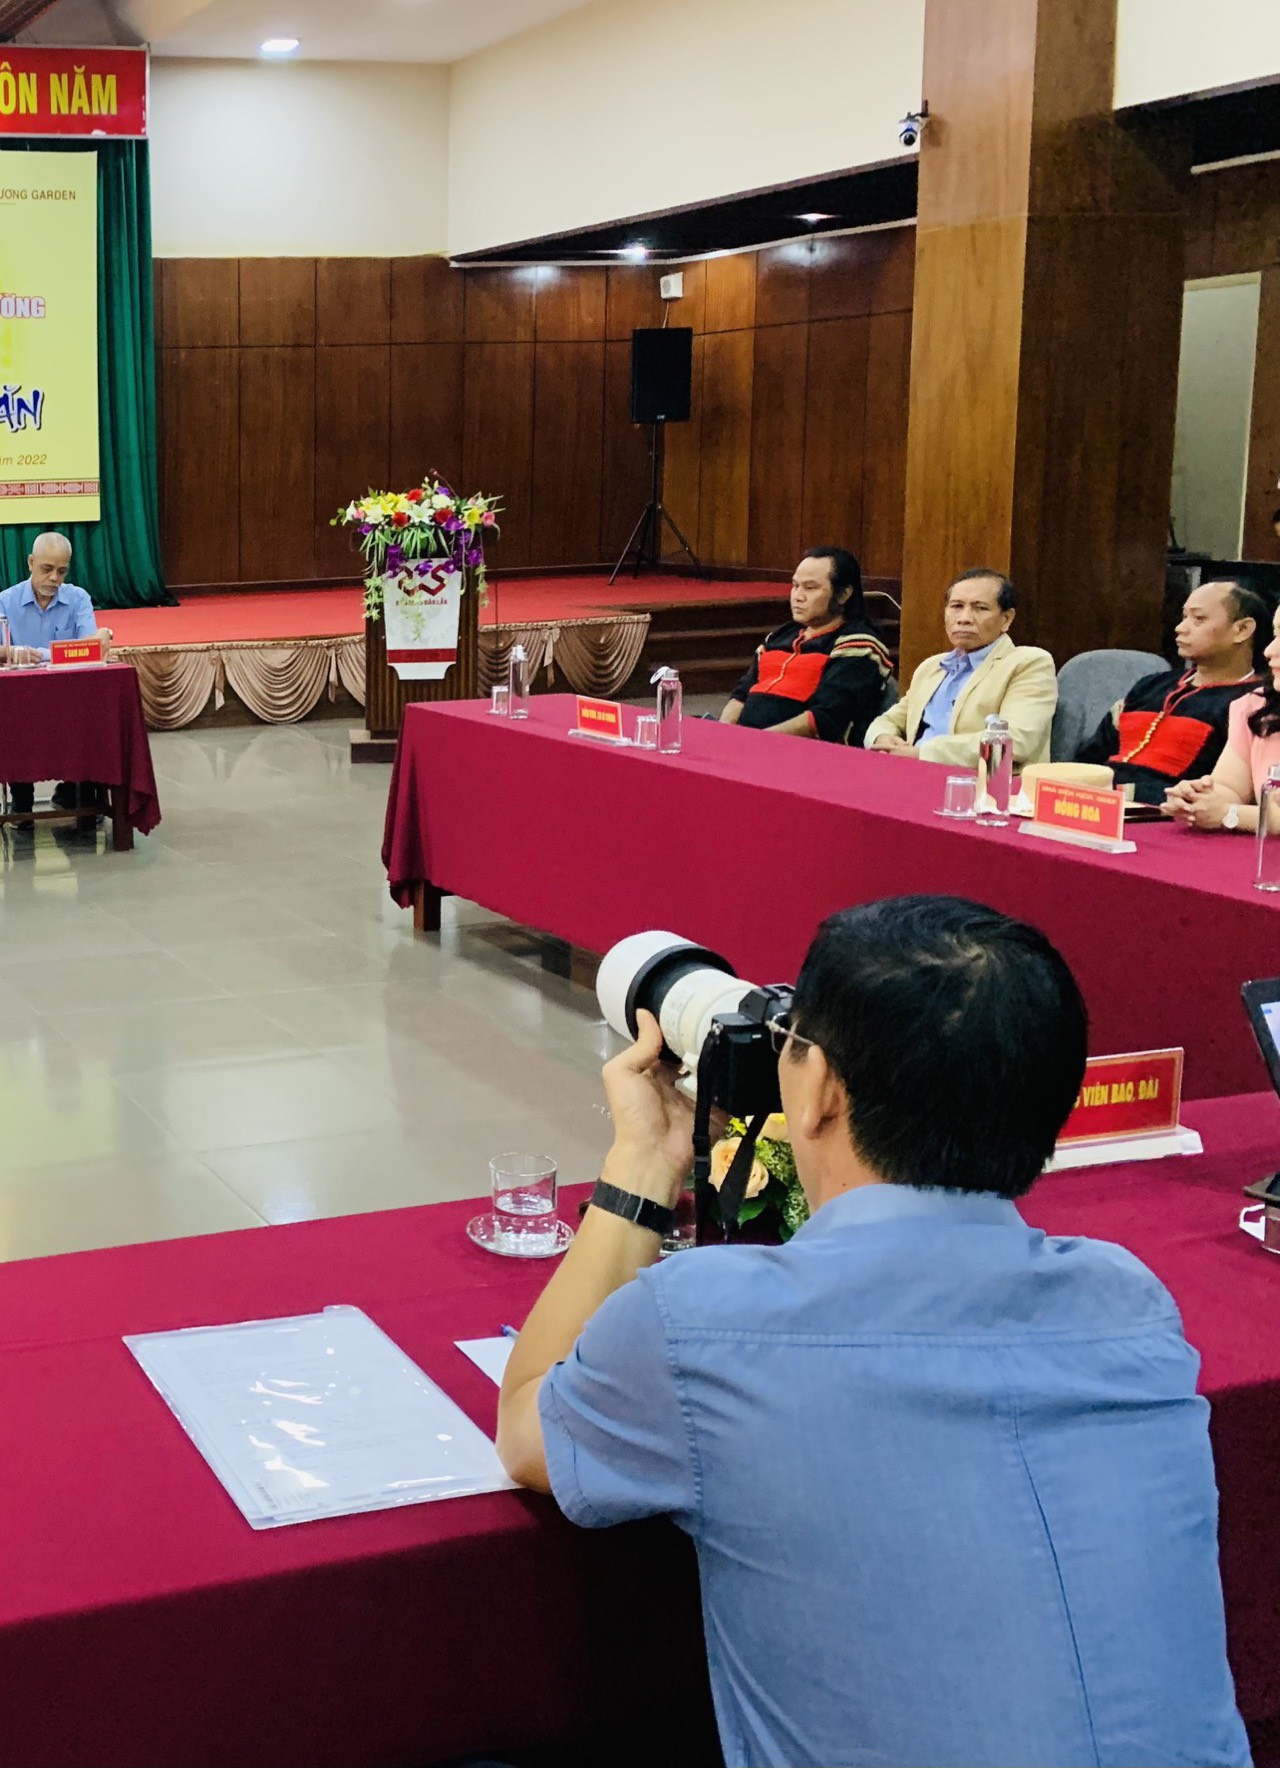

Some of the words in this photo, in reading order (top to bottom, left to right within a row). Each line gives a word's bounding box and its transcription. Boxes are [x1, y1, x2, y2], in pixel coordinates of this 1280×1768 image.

[49, 65, 118, 116] NĂM
[31, 189, 77, 201] GARDEN
[16, 453, 48, 466] 2022
